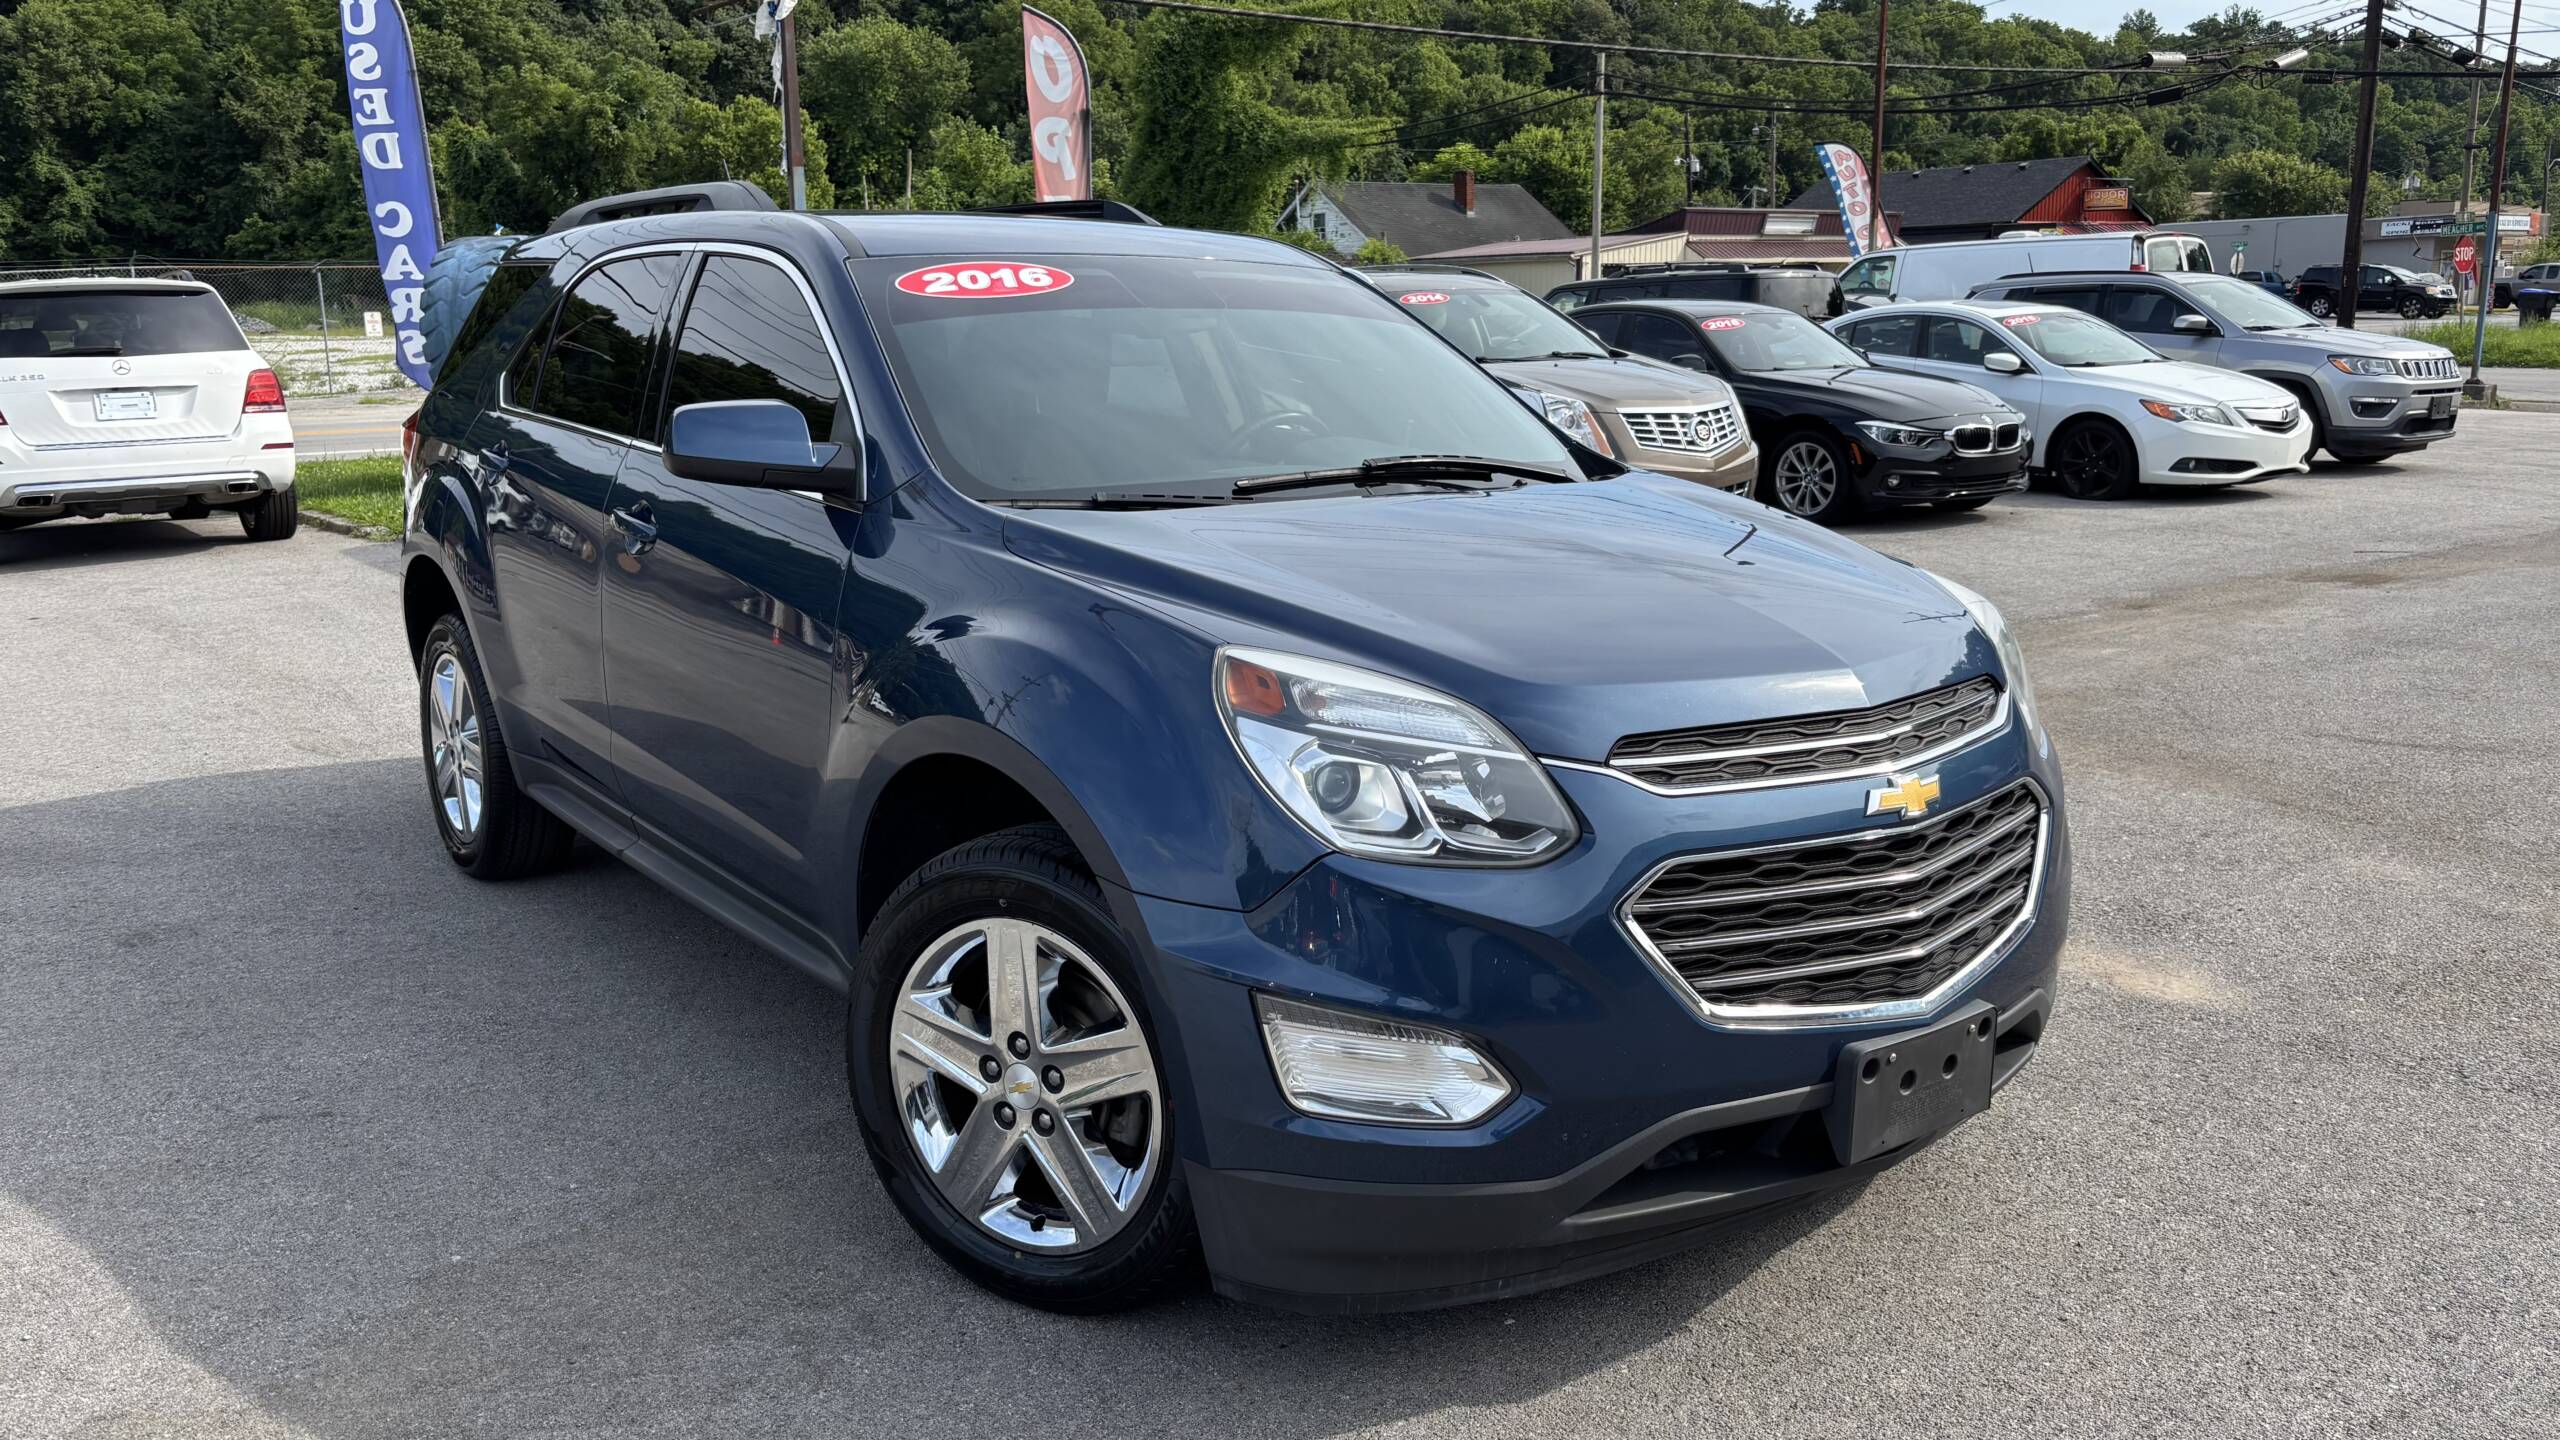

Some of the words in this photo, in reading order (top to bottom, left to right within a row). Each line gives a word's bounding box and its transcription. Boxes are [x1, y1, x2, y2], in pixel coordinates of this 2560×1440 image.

[1833, 149, 1868, 216] AUTO
[2084, 190, 2126, 202] LIQUOR
[2455, 246, 2474, 262] STOP
[921, 267, 1054, 294] 2016
[0, 374, 17, 383] LK
